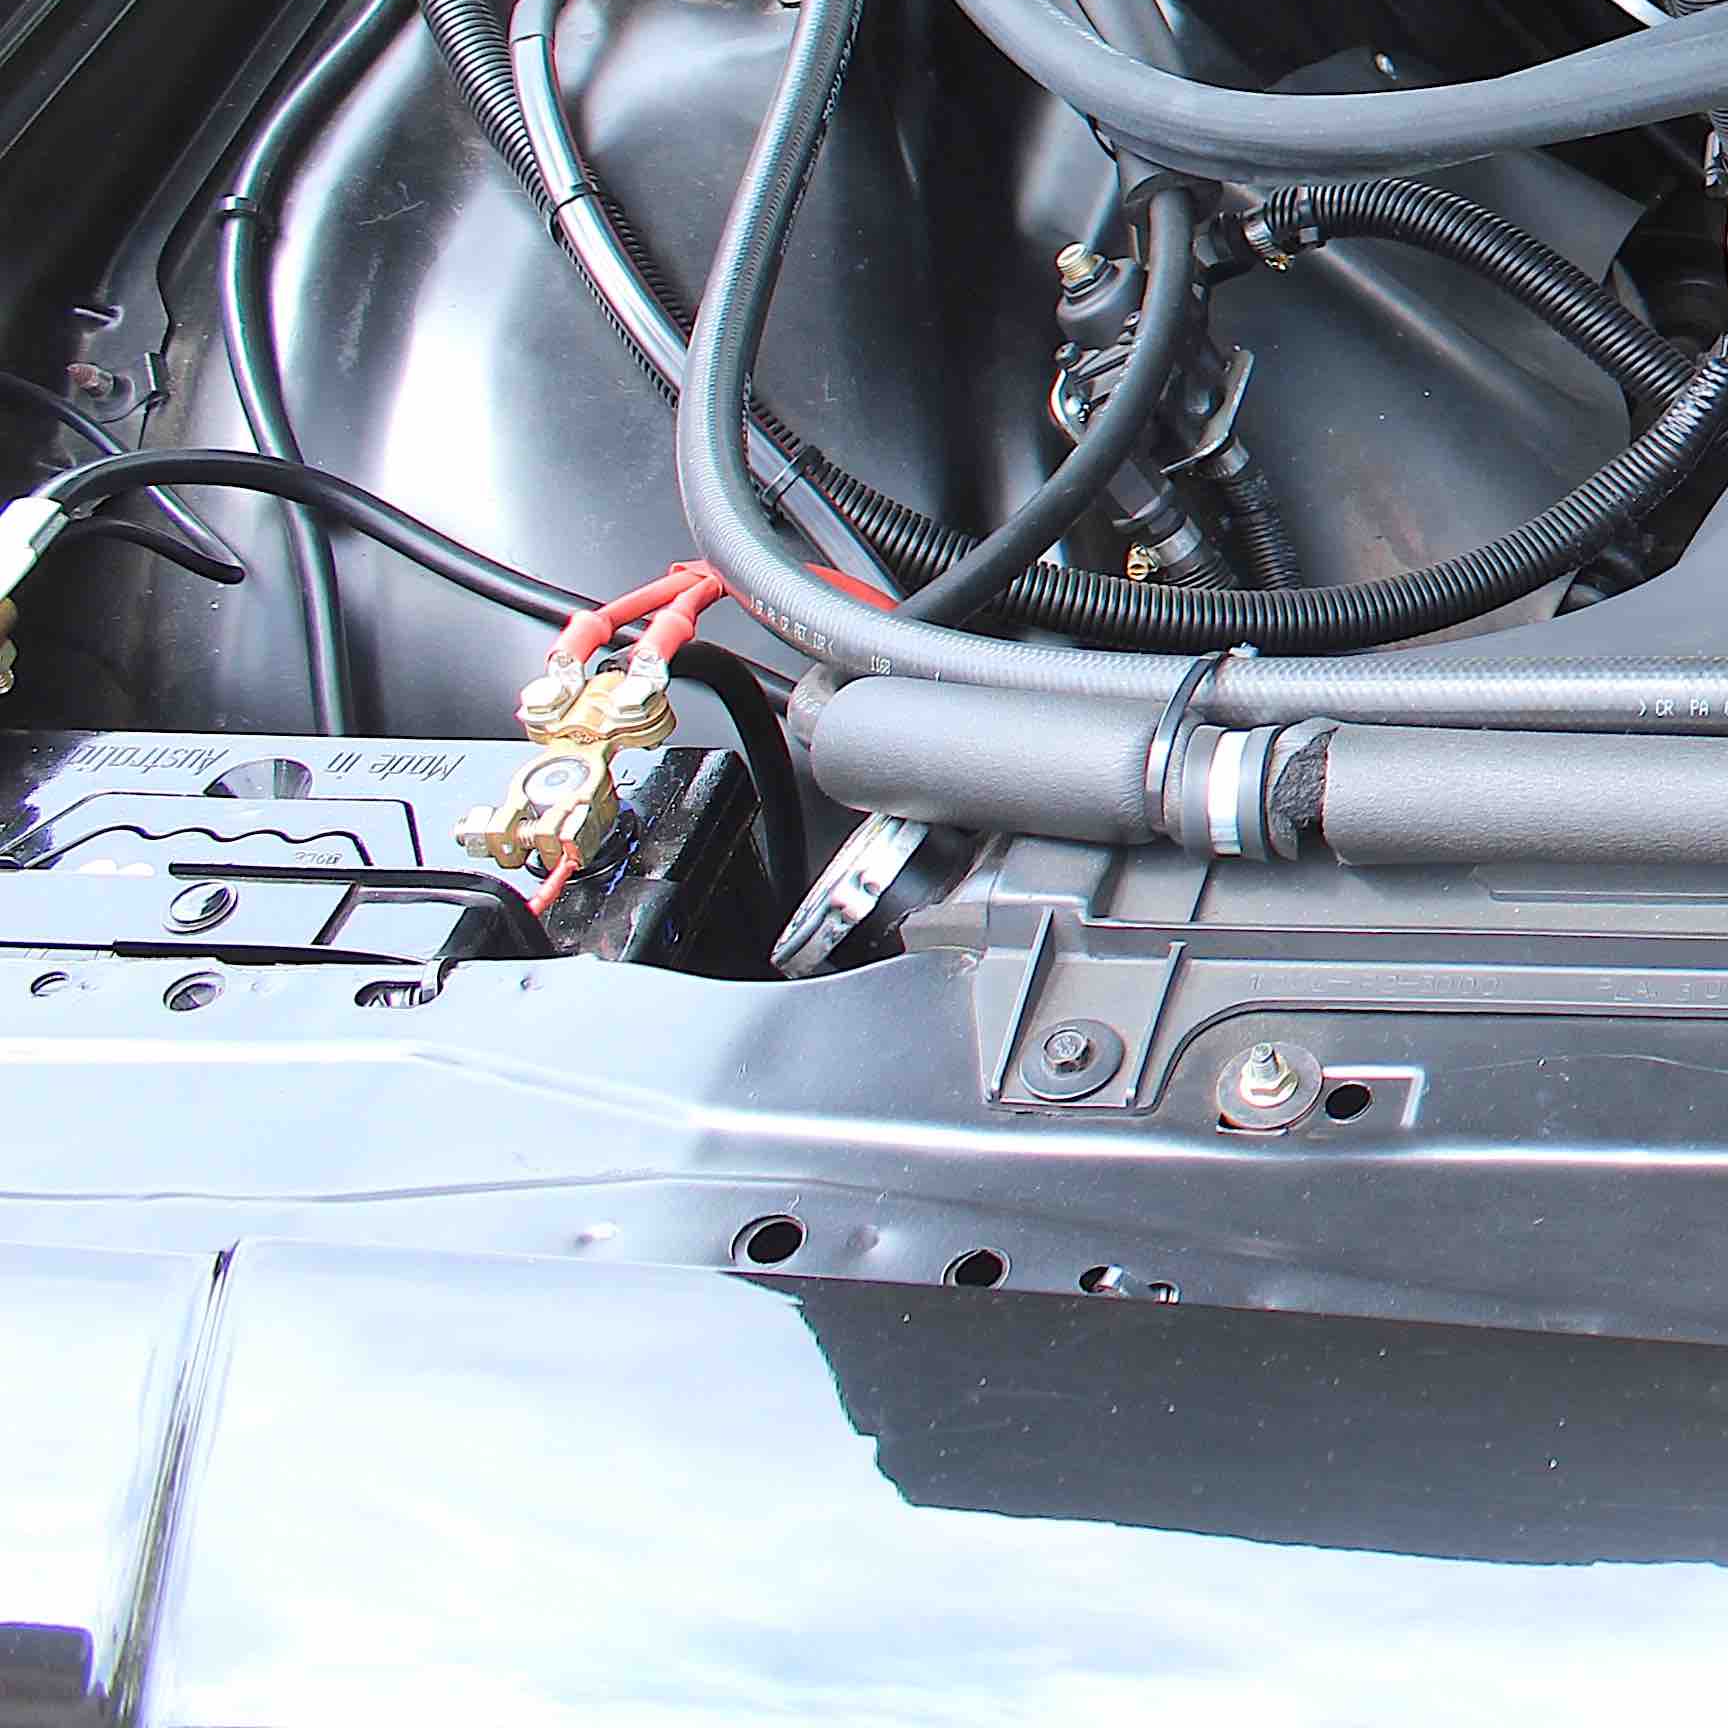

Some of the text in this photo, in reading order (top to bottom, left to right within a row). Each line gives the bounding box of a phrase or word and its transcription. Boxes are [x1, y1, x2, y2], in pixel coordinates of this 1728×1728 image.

[1655, 700, 1674, 717] CR
[1690, 700, 1709, 717] PA
[66, 744, 467, 782] Made in Australia
